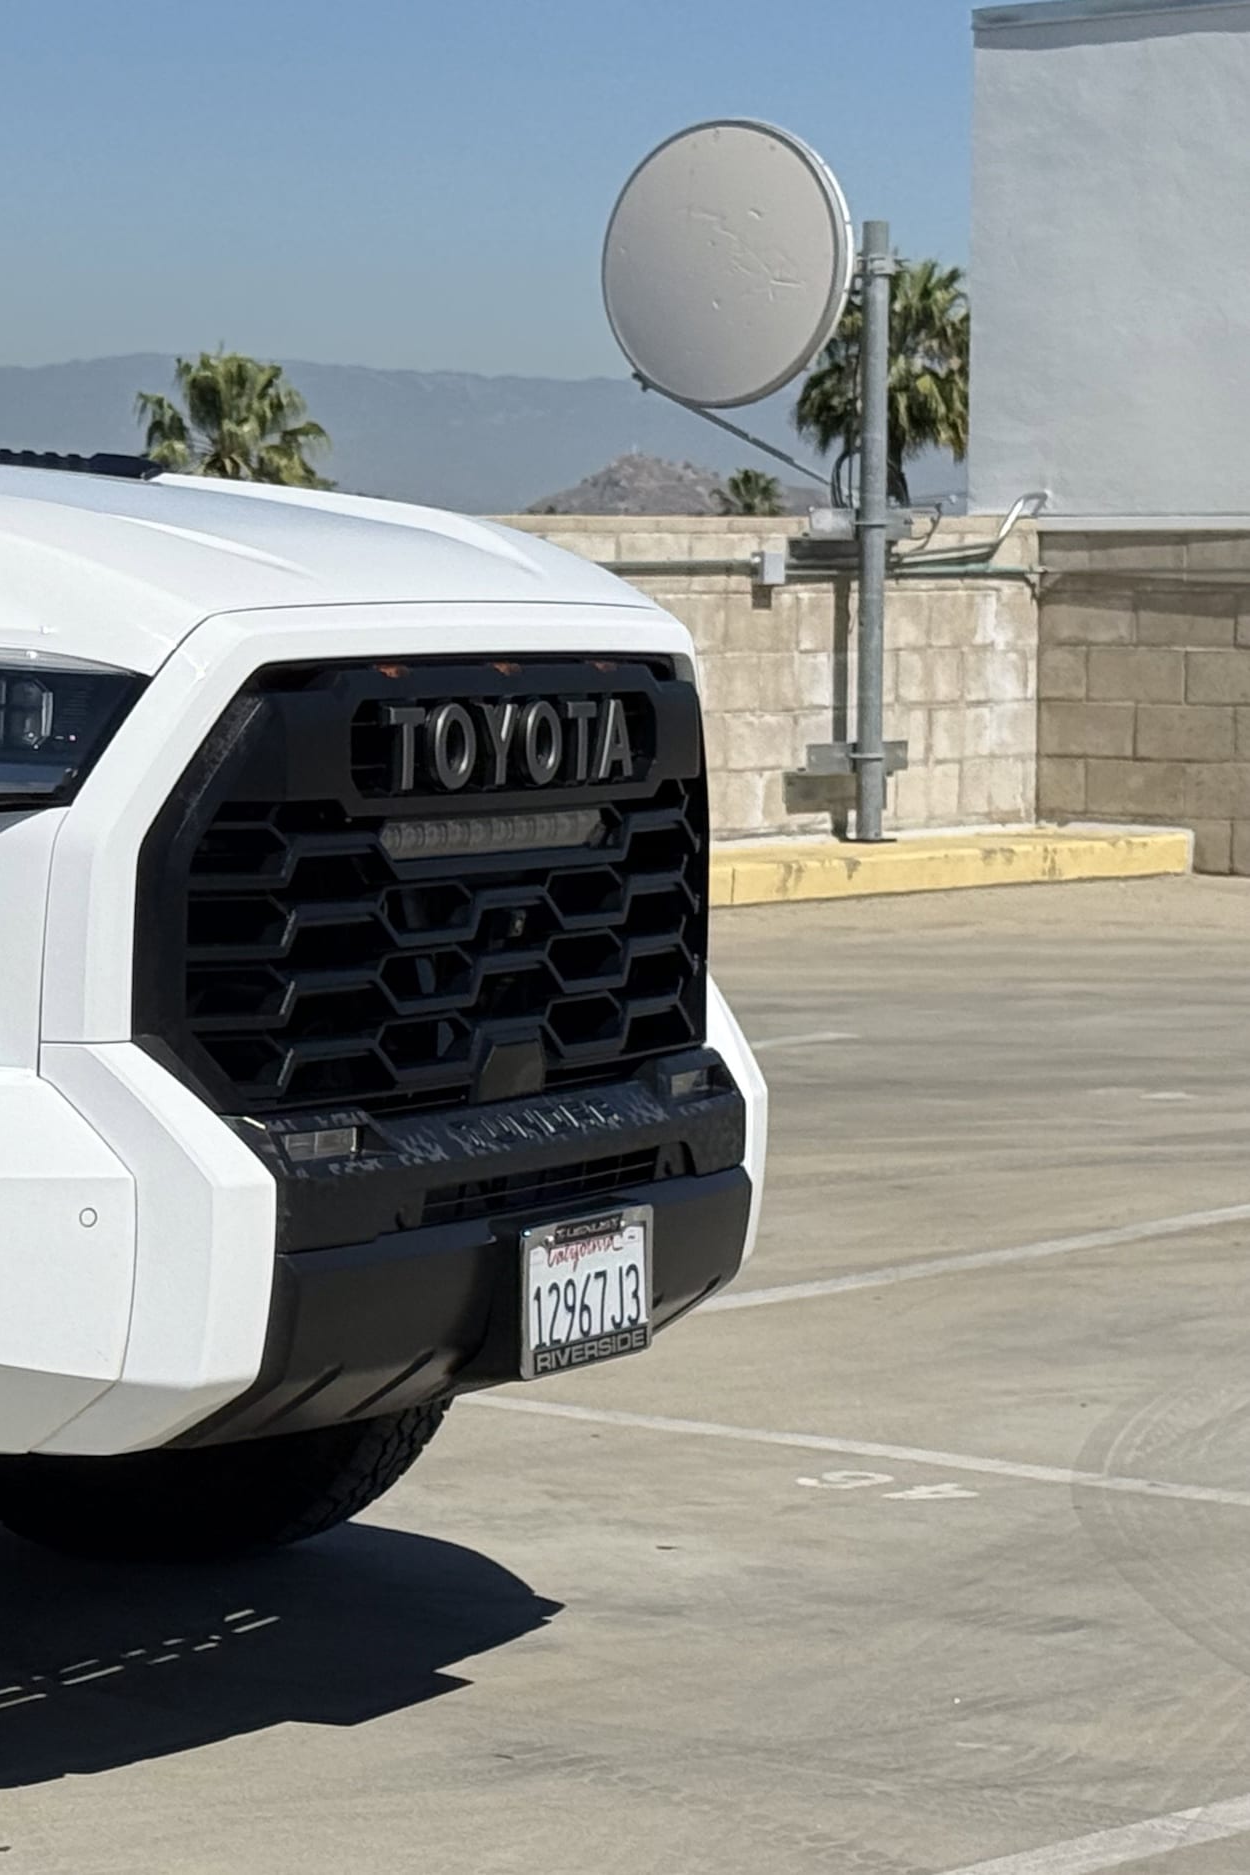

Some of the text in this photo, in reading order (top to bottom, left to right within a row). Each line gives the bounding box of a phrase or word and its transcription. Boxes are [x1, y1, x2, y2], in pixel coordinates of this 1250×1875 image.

[389, 698, 633, 791] TOYOTA
[533, 1263, 641, 1349] 12967J3
[536, 1329, 646, 1373] RIVERSIDE
